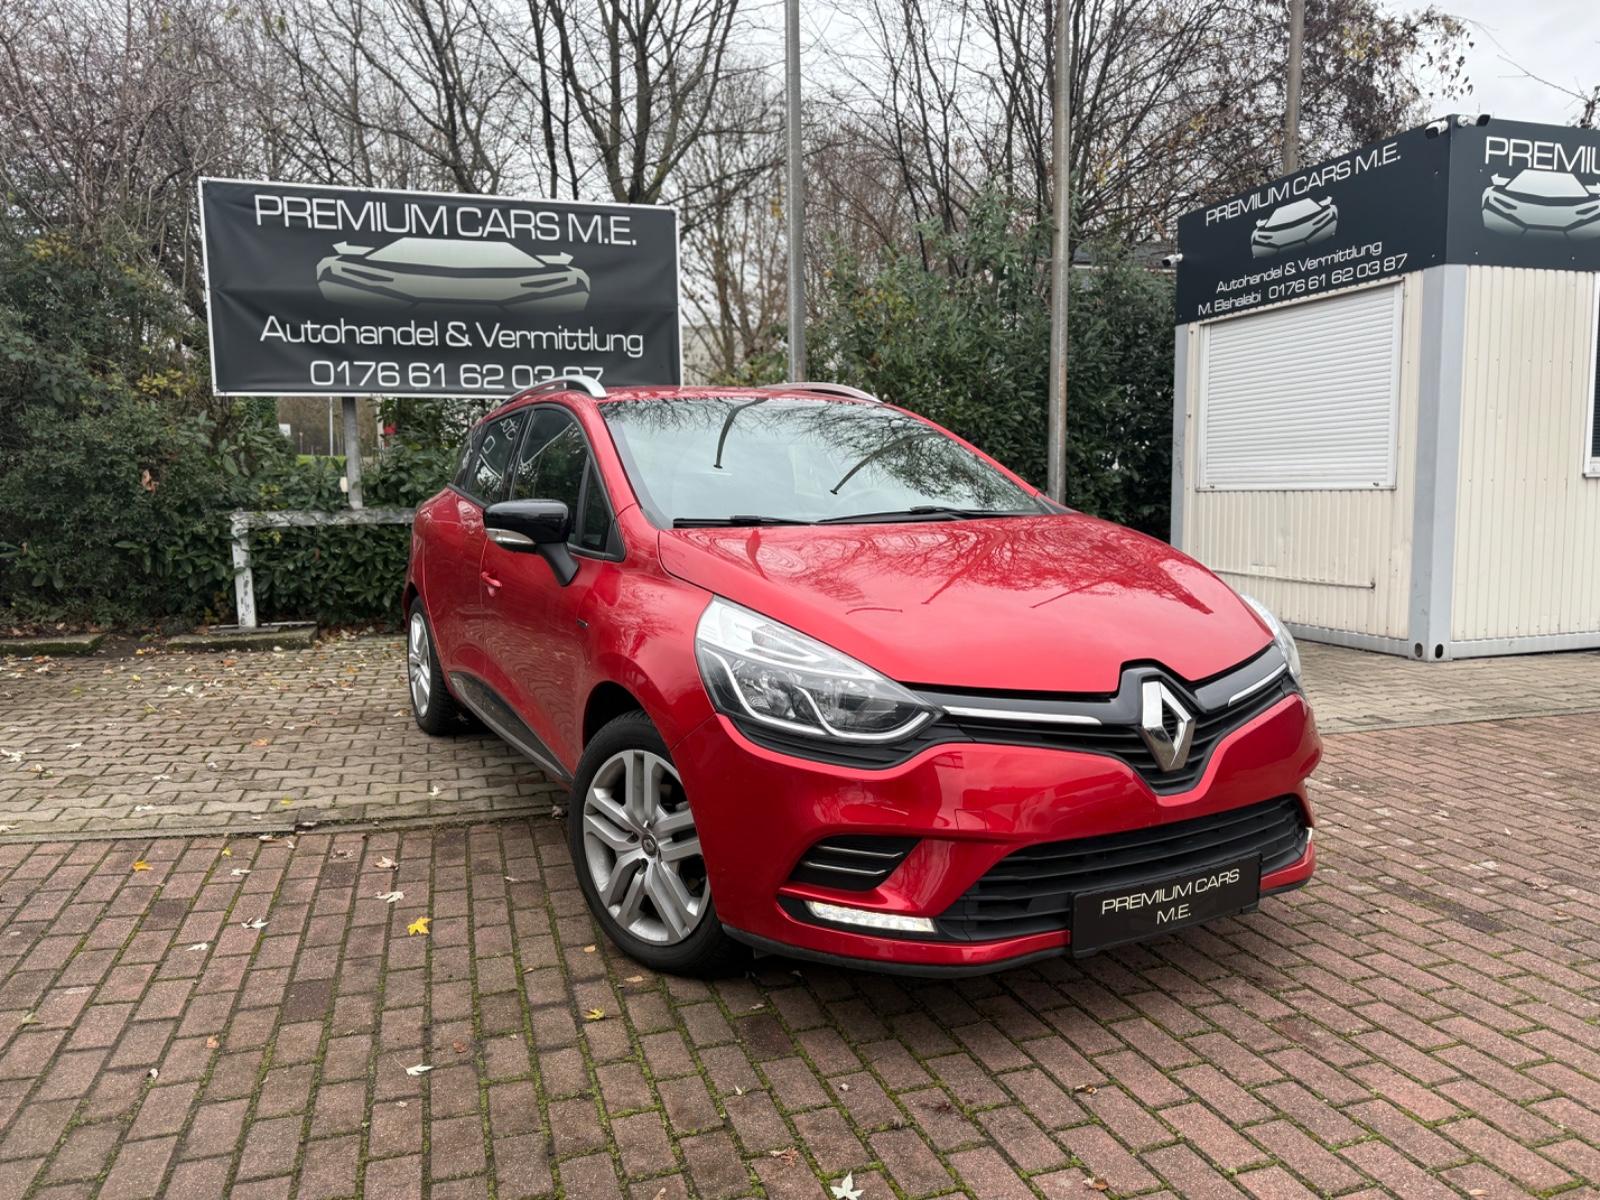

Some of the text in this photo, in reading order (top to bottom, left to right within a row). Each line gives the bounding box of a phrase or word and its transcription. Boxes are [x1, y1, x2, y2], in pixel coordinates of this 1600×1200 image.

[1205, 141, 1401, 227] PREMIUM CARS M.E.
[254, 194, 637, 246] PREMIUM CARS M.E.
[1197, 302, 1212, 316] M.
[1268, 279, 1305, 299] 0176
[1308, 273, 1326, 290] 61
[1331, 267, 1354, 285] 62
[1356, 260, 1380, 278] 03
[1383, 252, 1408, 272] 87
[1215, 241, 1383, 294] Autohandel & Vermittlung
[260, 315, 644, 358] Autohandel & Vermittlung
[310, 360, 400, 387] 0176
[408, 362, 446, 388] 61
[459, 363, 505, 389] 62
[1101, 868, 1240, 915] PREMIUM CARS
[1156, 903, 1191, 925] M.E.
